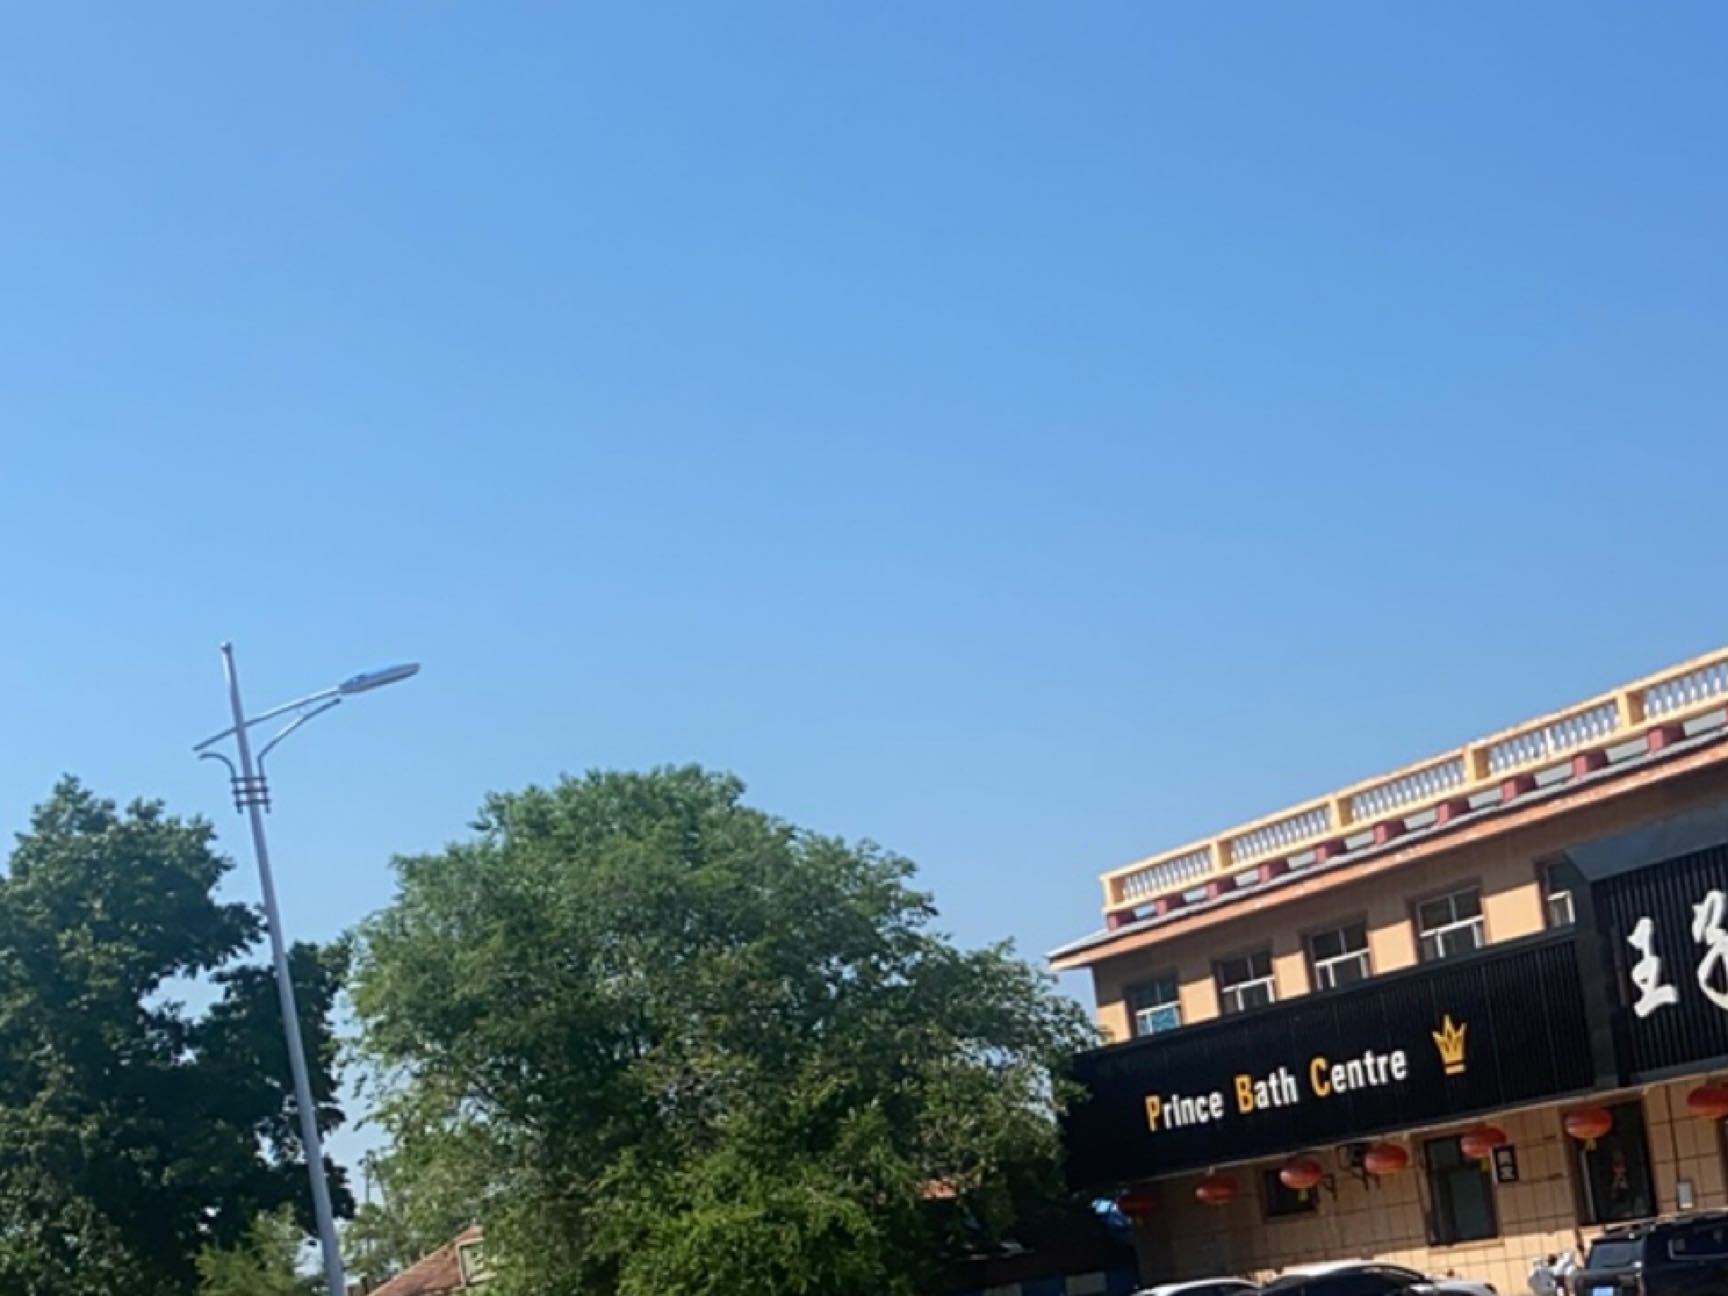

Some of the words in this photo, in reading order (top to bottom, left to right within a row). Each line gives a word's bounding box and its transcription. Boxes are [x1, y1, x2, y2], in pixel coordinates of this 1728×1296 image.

[1144, 1090, 1225, 1132] Prince
[1233, 1066, 1299, 1115] Bath
[1309, 1049, 1408, 1098] Centre
